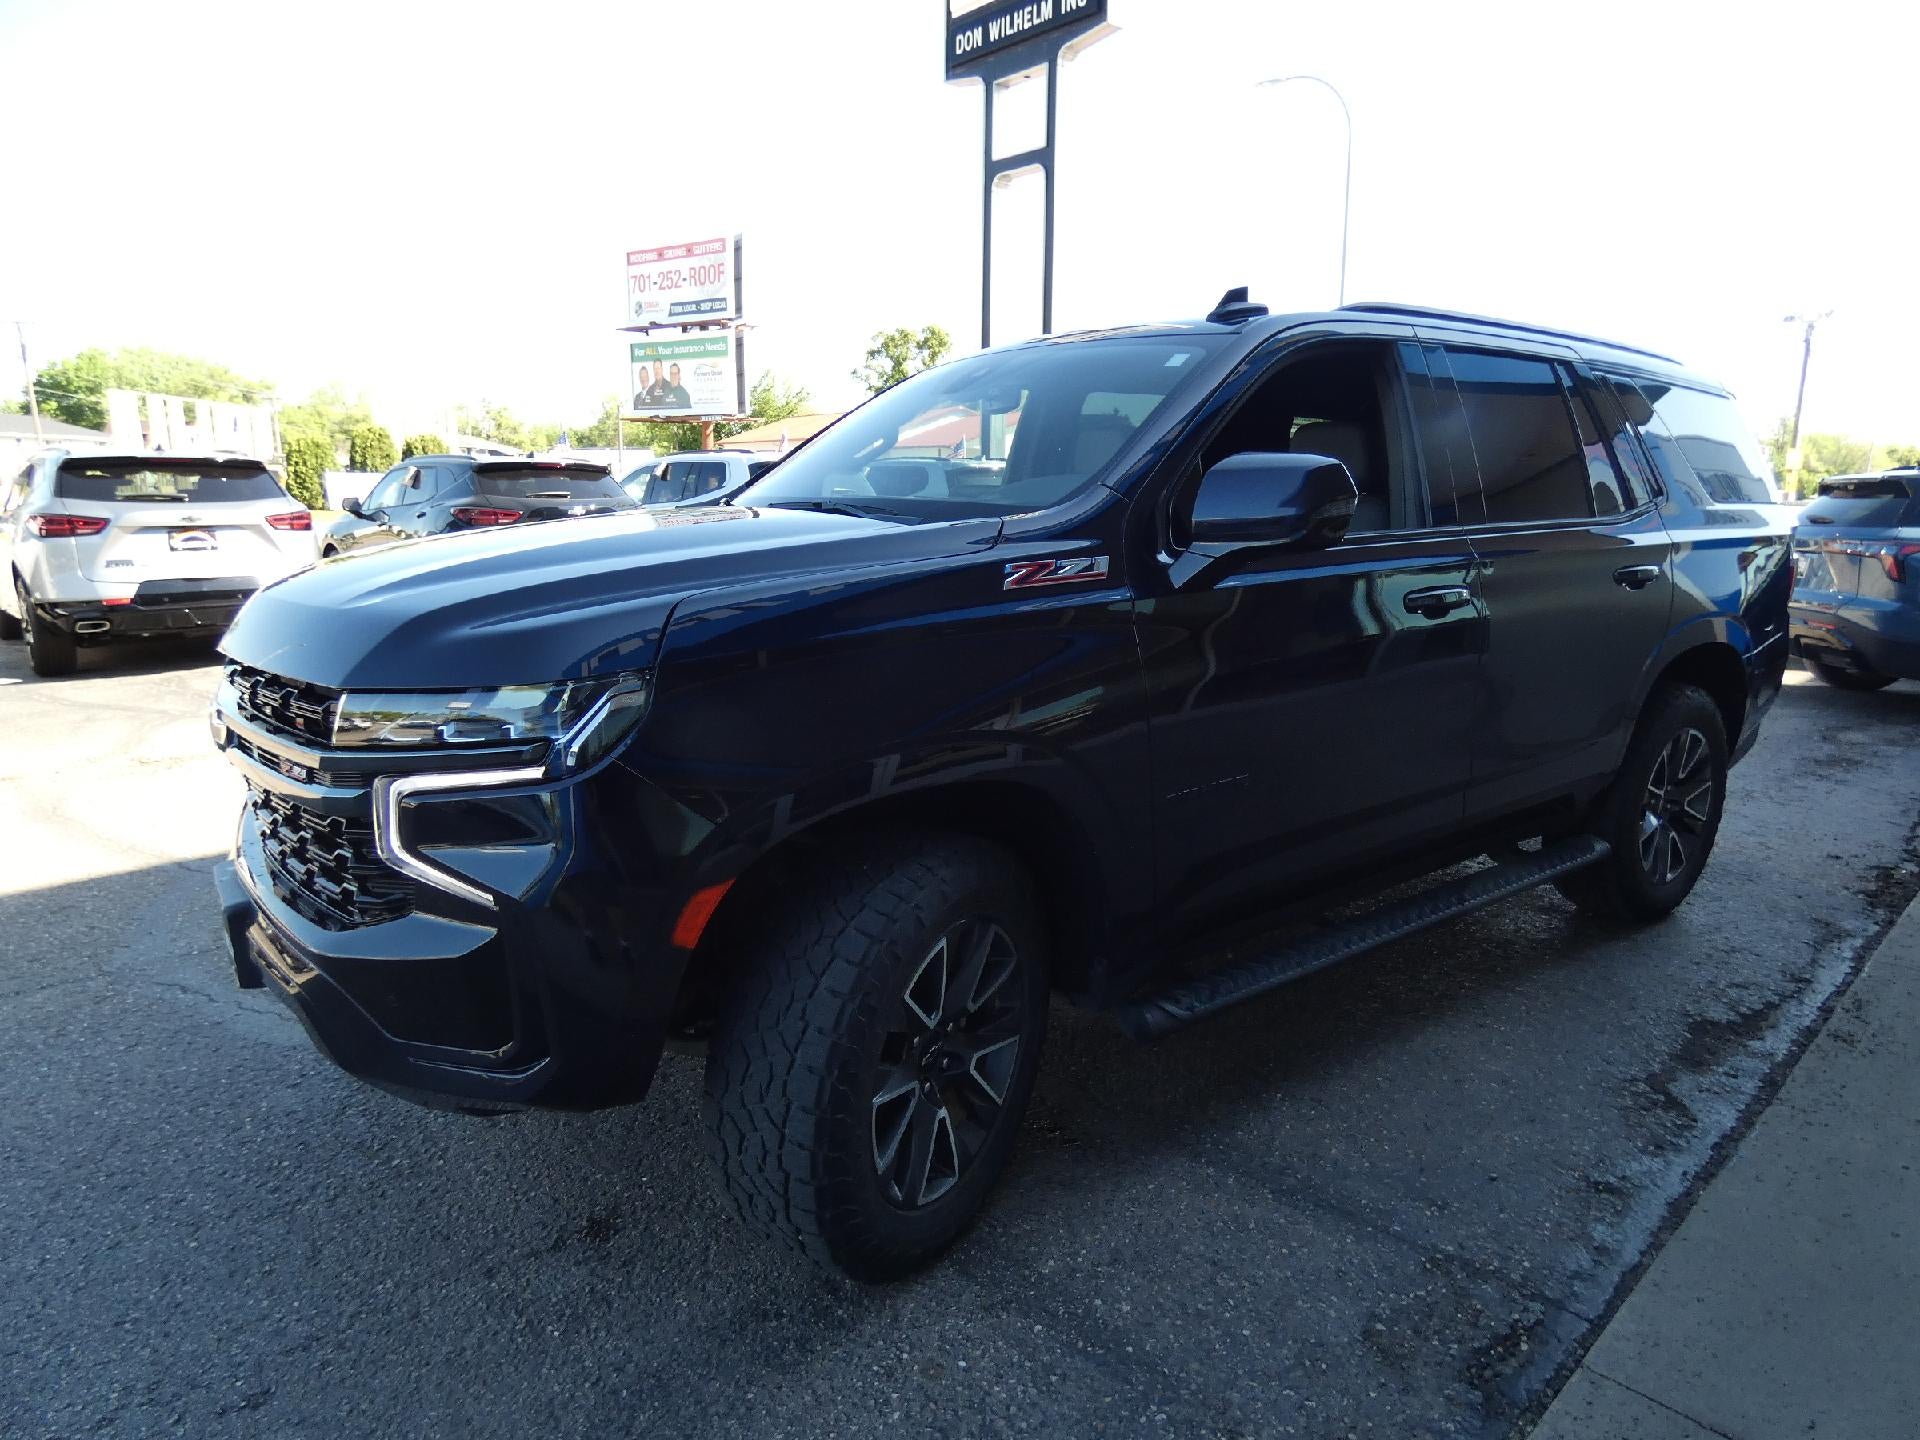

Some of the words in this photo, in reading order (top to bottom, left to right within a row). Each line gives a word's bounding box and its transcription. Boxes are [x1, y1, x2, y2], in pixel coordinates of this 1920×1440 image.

[955, 26, 983, 55] DON
[988, 1, 1053, 42] WILHELM
[630, 263, 725, 294] 701-252-ROOF
[635, 348, 645, 357] For
[646, 347, 657, 356] ALL
[658, 345, 672, 355] Your
[673, 344, 704, 354] Insurance
[705, 341, 726, 351] Needs
[1003, 555, 1109, 590] Z71
